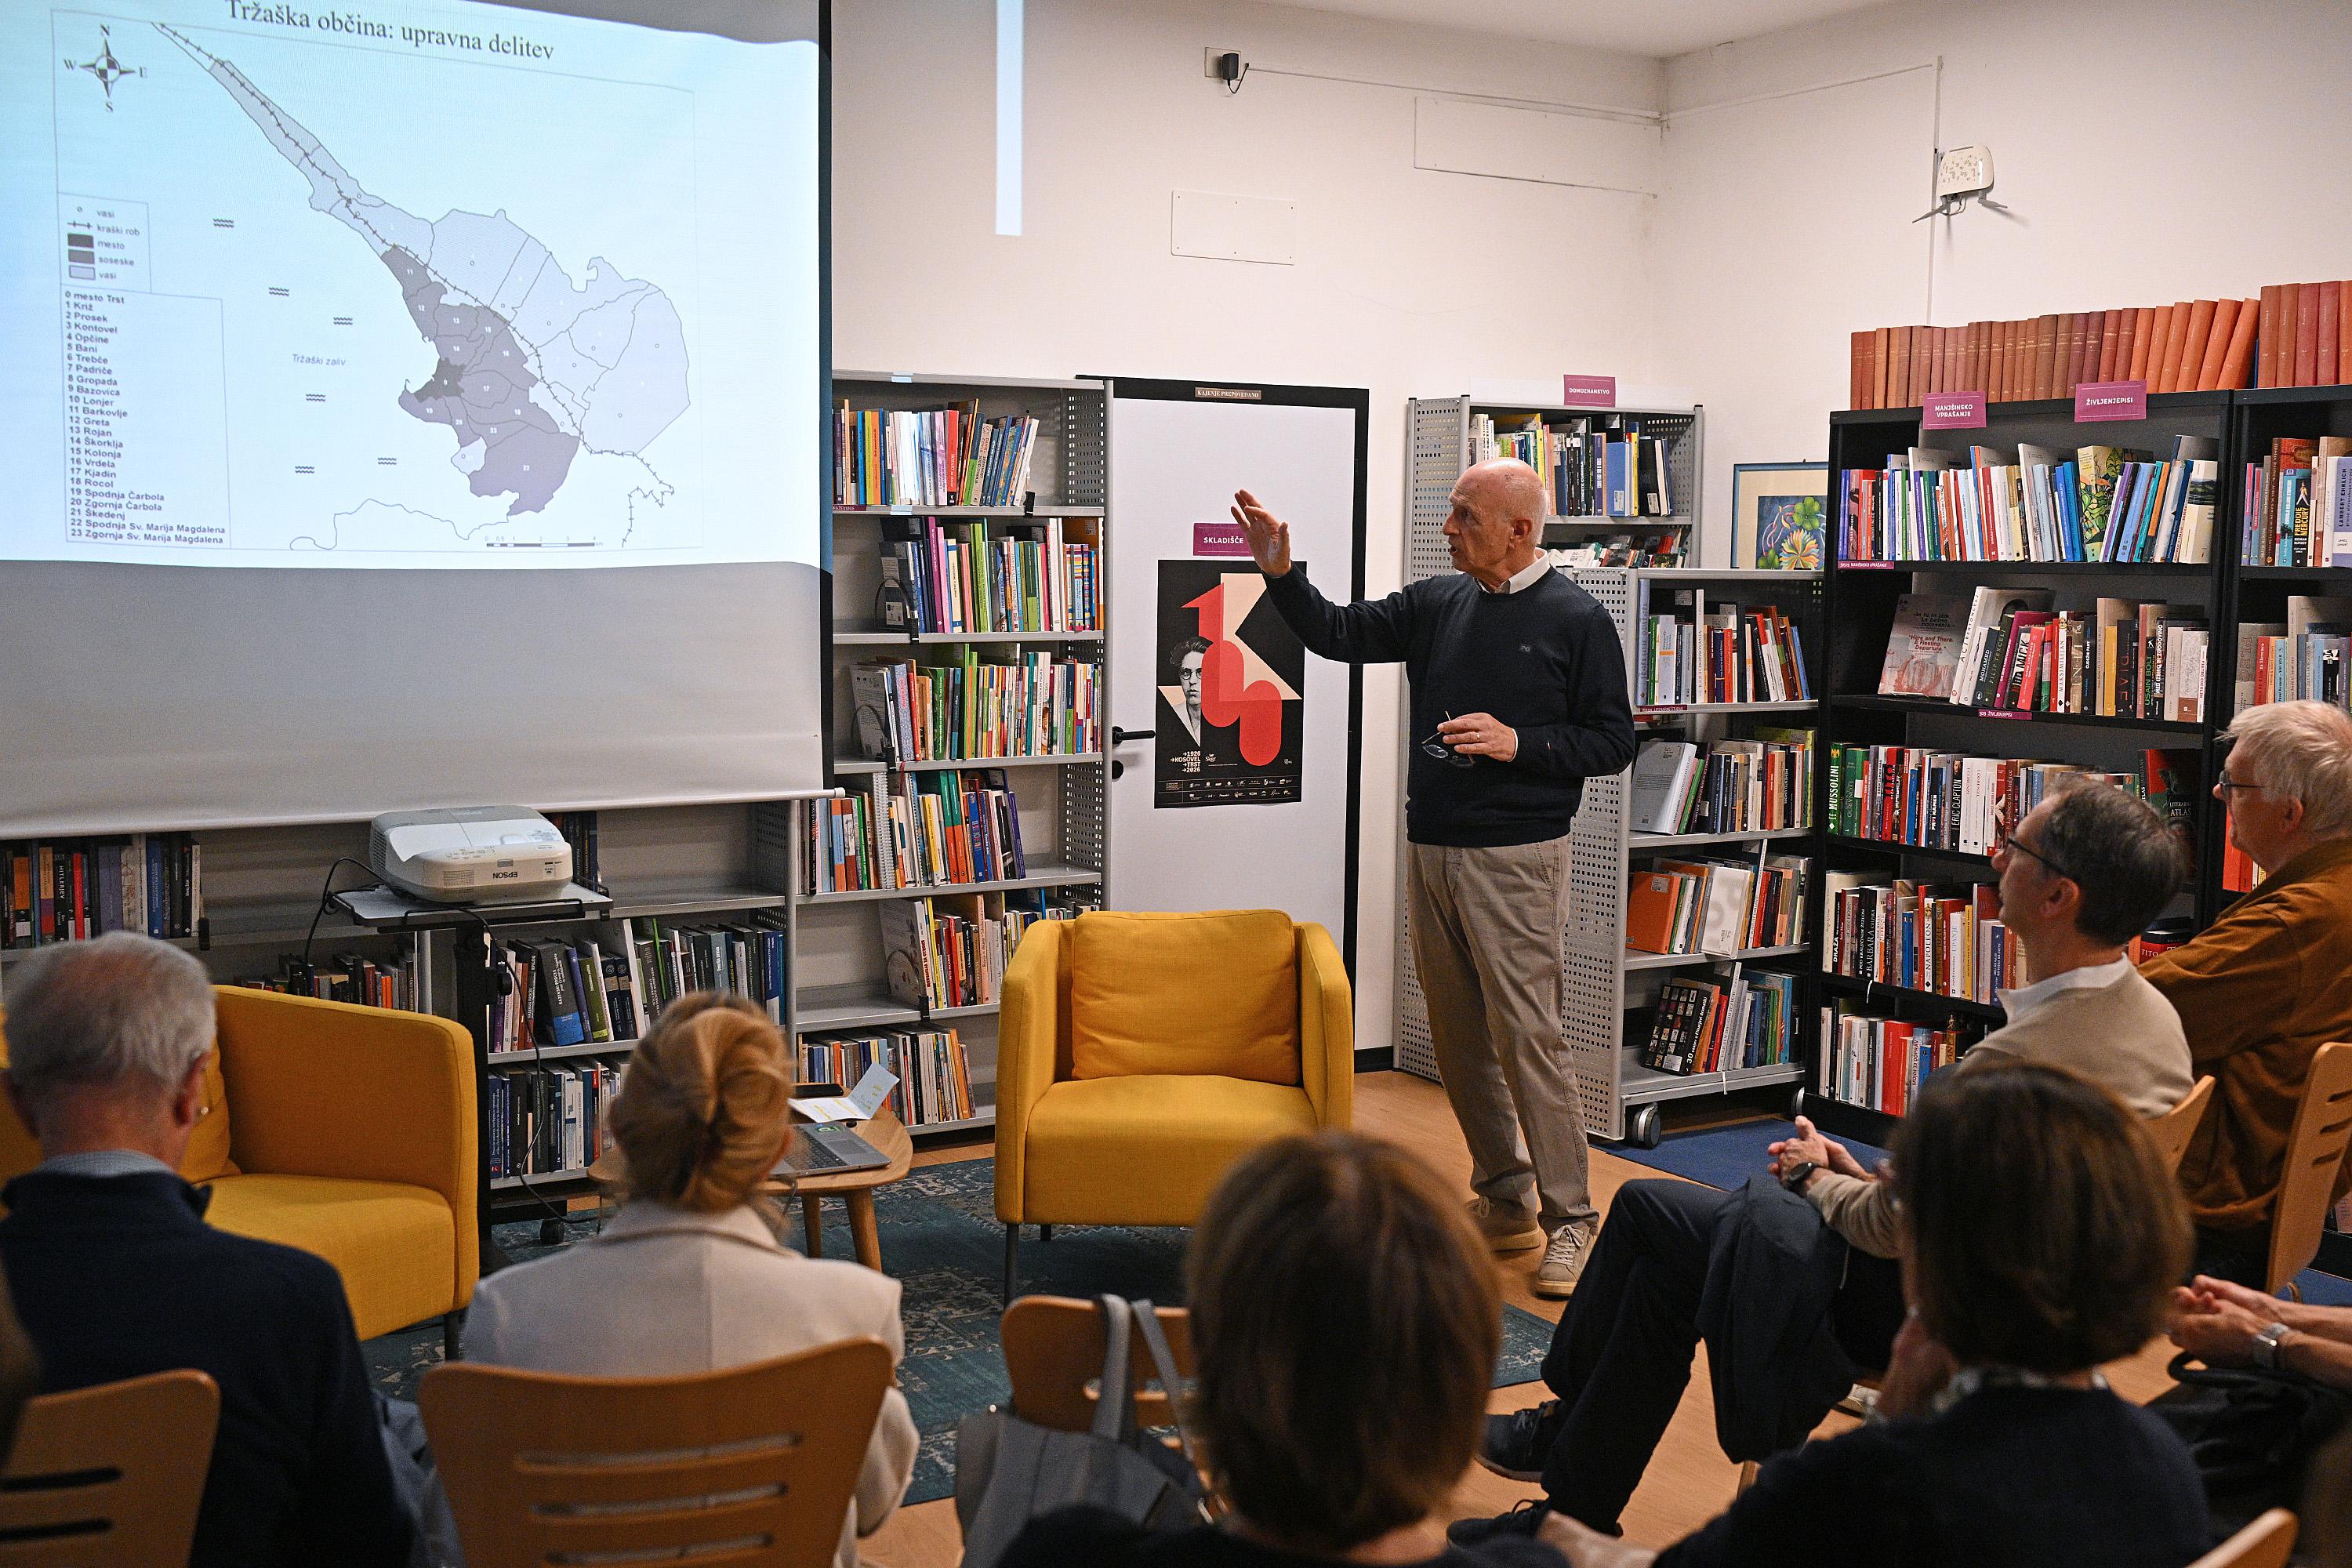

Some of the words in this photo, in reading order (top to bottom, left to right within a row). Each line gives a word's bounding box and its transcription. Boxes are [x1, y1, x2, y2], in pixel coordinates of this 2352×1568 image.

[100, 24, 110, 37] N
[226, 0, 310, 29] Tržaška
[318, 11, 393, 38] občina:
[401, 26, 482, 50] upravna
[488, 34, 555, 60] delitev
[64, 58, 77, 71] W
[140, 66, 147, 78] E
[105, 101, 114, 113] S
[97, 223, 122, 235] kraški
[125, 227, 140, 236] rob
[97, 241, 125, 250] mesto
[99, 257, 134, 267] soseske
[99, 271, 116, 280] vasi
[74, 292, 103, 303] mesto
[107, 295, 125, 304] Trst
[74, 302, 94, 311] Križ
[74, 313, 108, 322] Prosek
[74, 322, 118, 334] Kontovel
[75, 333, 109, 345] Opčine
[75, 343, 97, 353] Bani
[292, 354, 323, 364] Tržaški
[77, 376, 118, 387] Gropada
[77, 386, 120, 396] Bazovica
[83, 397, 114, 407] Lonjer
[2085, 397, 2133, 406] ŽIVLJENJEPISI
[82, 406, 128, 418] Barkovlje
[83, 417, 110, 426] Greta
[84, 426, 112, 437] Rojan
[84, 437, 124, 449] Škorklja
[85, 448, 122, 459] Kolonja
[85, 459, 115, 469] Vrdela
[85, 478, 114, 488] Rocol
[85, 489, 125, 500] Spodnja
[129, 488, 165, 502] Čarbola
[85, 499, 122, 510] Zgornja
[125, 499, 162, 511] Čarbola
[85, 509, 125, 521] Škedenj
[2300, 506, 2309, 536] MERCURY
[85, 520, 125, 531] Spodnja
[129, 522, 143, 531] Sv.
[147, 523, 173, 532] Marija
[177, 524, 225, 535] Magdalena
[85, 530, 123, 541] Zgornja
[127, 532, 141, 541] Sv.
[144, 533, 171, 543] Marija
[175, 535, 223, 545] Magdalena
[1203, 535, 1244, 544] SKLADIŠČE
[2016, 639, 2029, 669] MICK
[1980, 649, 1990, 681] MOHAMED
[1829, 765, 1839, 811] MUSSOLINI
[1952, 779, 1961, 808] CLAPTON
[1866, 931, 1875, 971] BARBARA
[2141, 949, 2158, 957] TITO
[554, 985, 564, 1005] KAZENSKI
[1687, 1052, 1693, 1064] 30
[1699, 996, 1708, 1016] dramatiki
